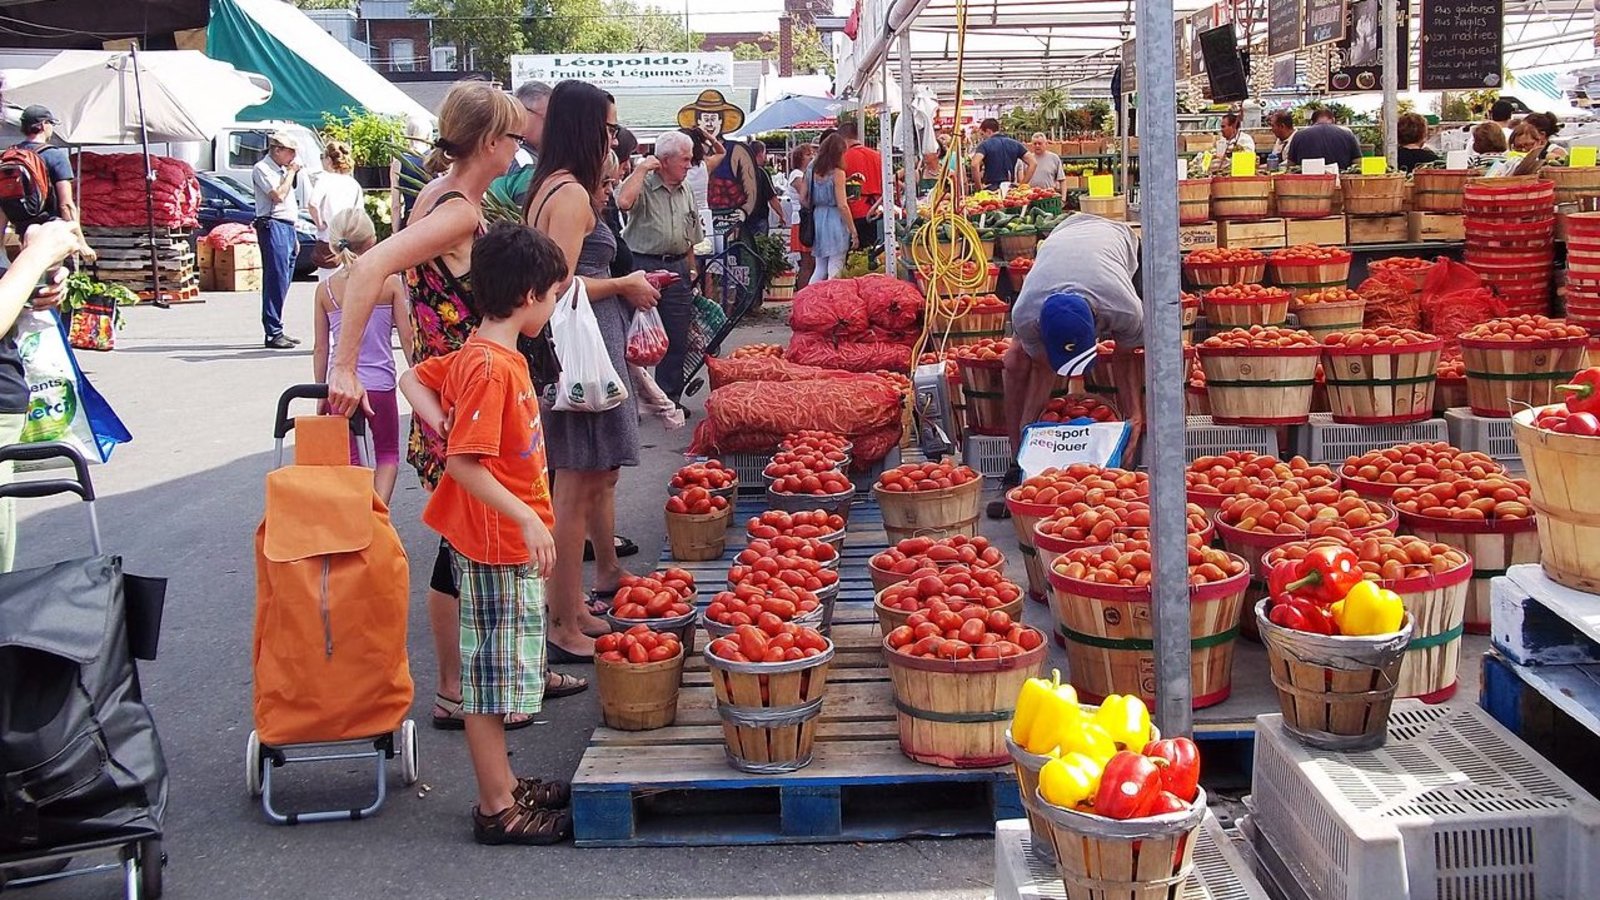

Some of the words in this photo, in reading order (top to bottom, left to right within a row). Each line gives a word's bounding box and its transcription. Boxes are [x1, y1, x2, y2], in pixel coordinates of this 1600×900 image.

[554, 57, 689, 68] Léopoldo
[550, 70, 596, 78] Fruits
[602, 70, 615, 78] &
[621, 69, 692, 79] Légumes
